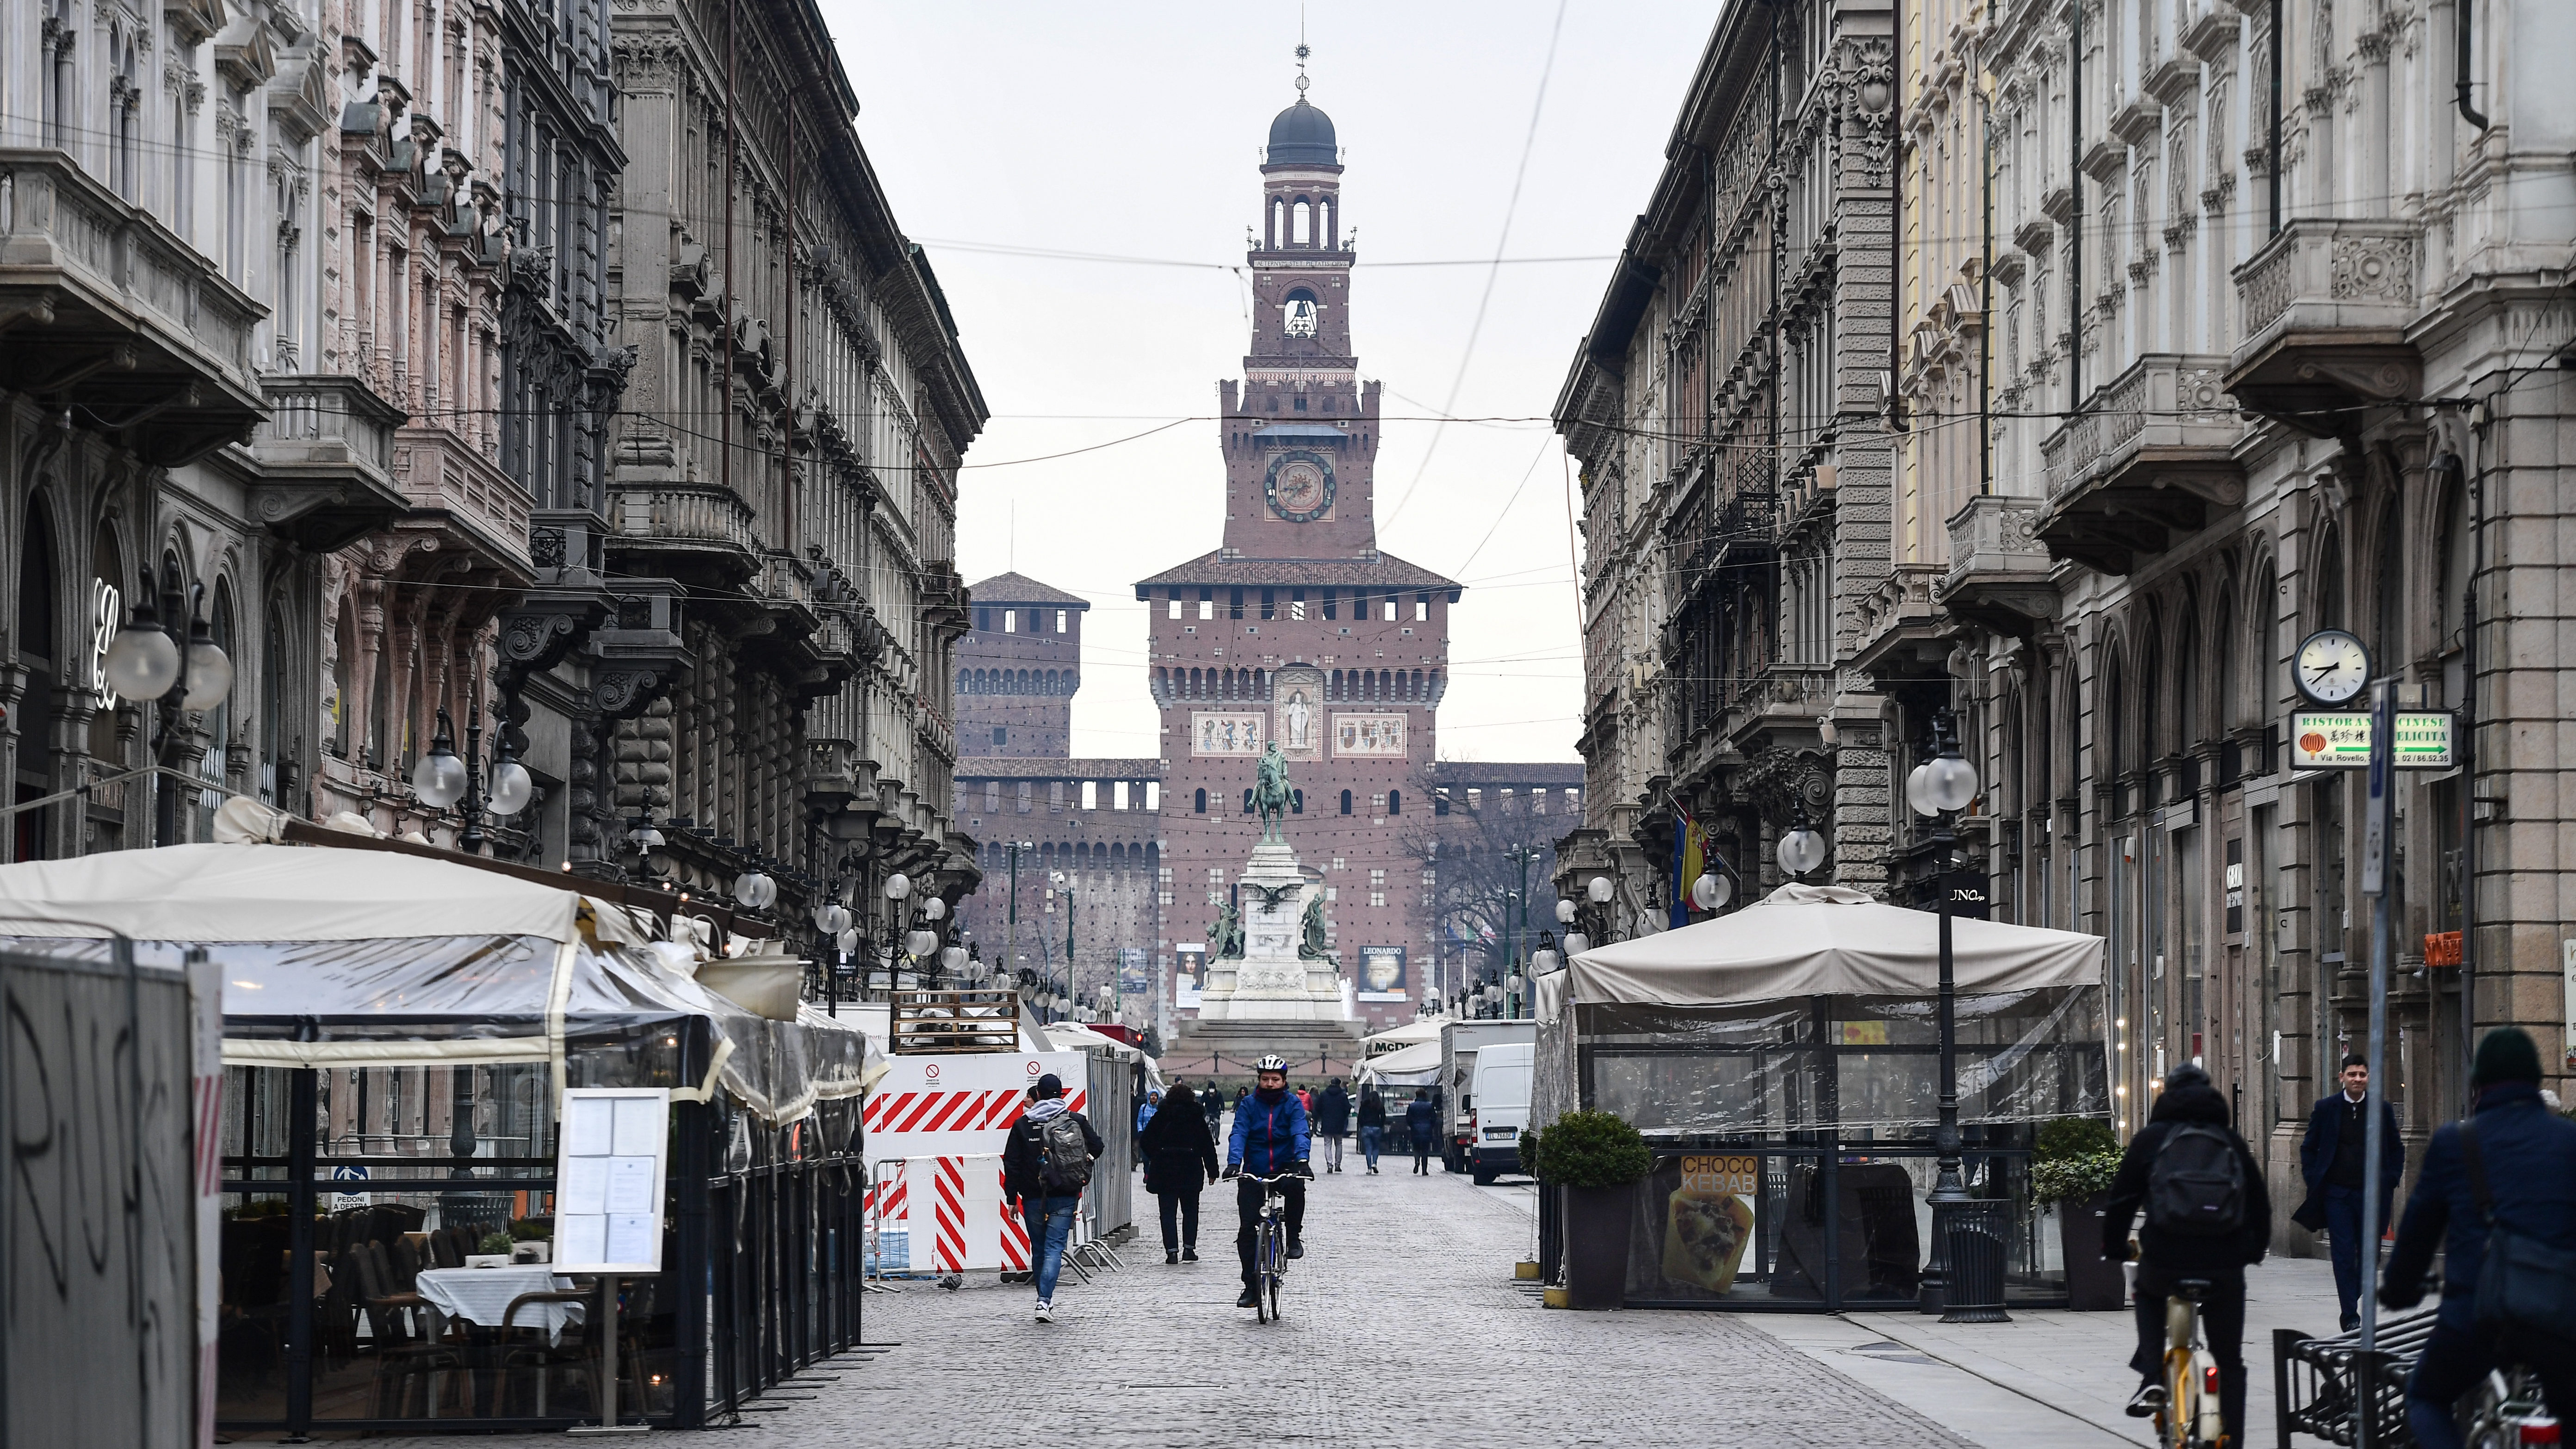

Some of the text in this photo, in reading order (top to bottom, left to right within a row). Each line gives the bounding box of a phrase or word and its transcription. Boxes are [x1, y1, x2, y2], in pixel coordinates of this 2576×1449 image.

[2303, 718, 2446, 727] RISTORAN CINESE
[2336, 754, 2366, 762] Rovello,
[1683, 1157, 1757, 1173] CHOCO
[1683, 1174, 1756, 1192] KEBAB
